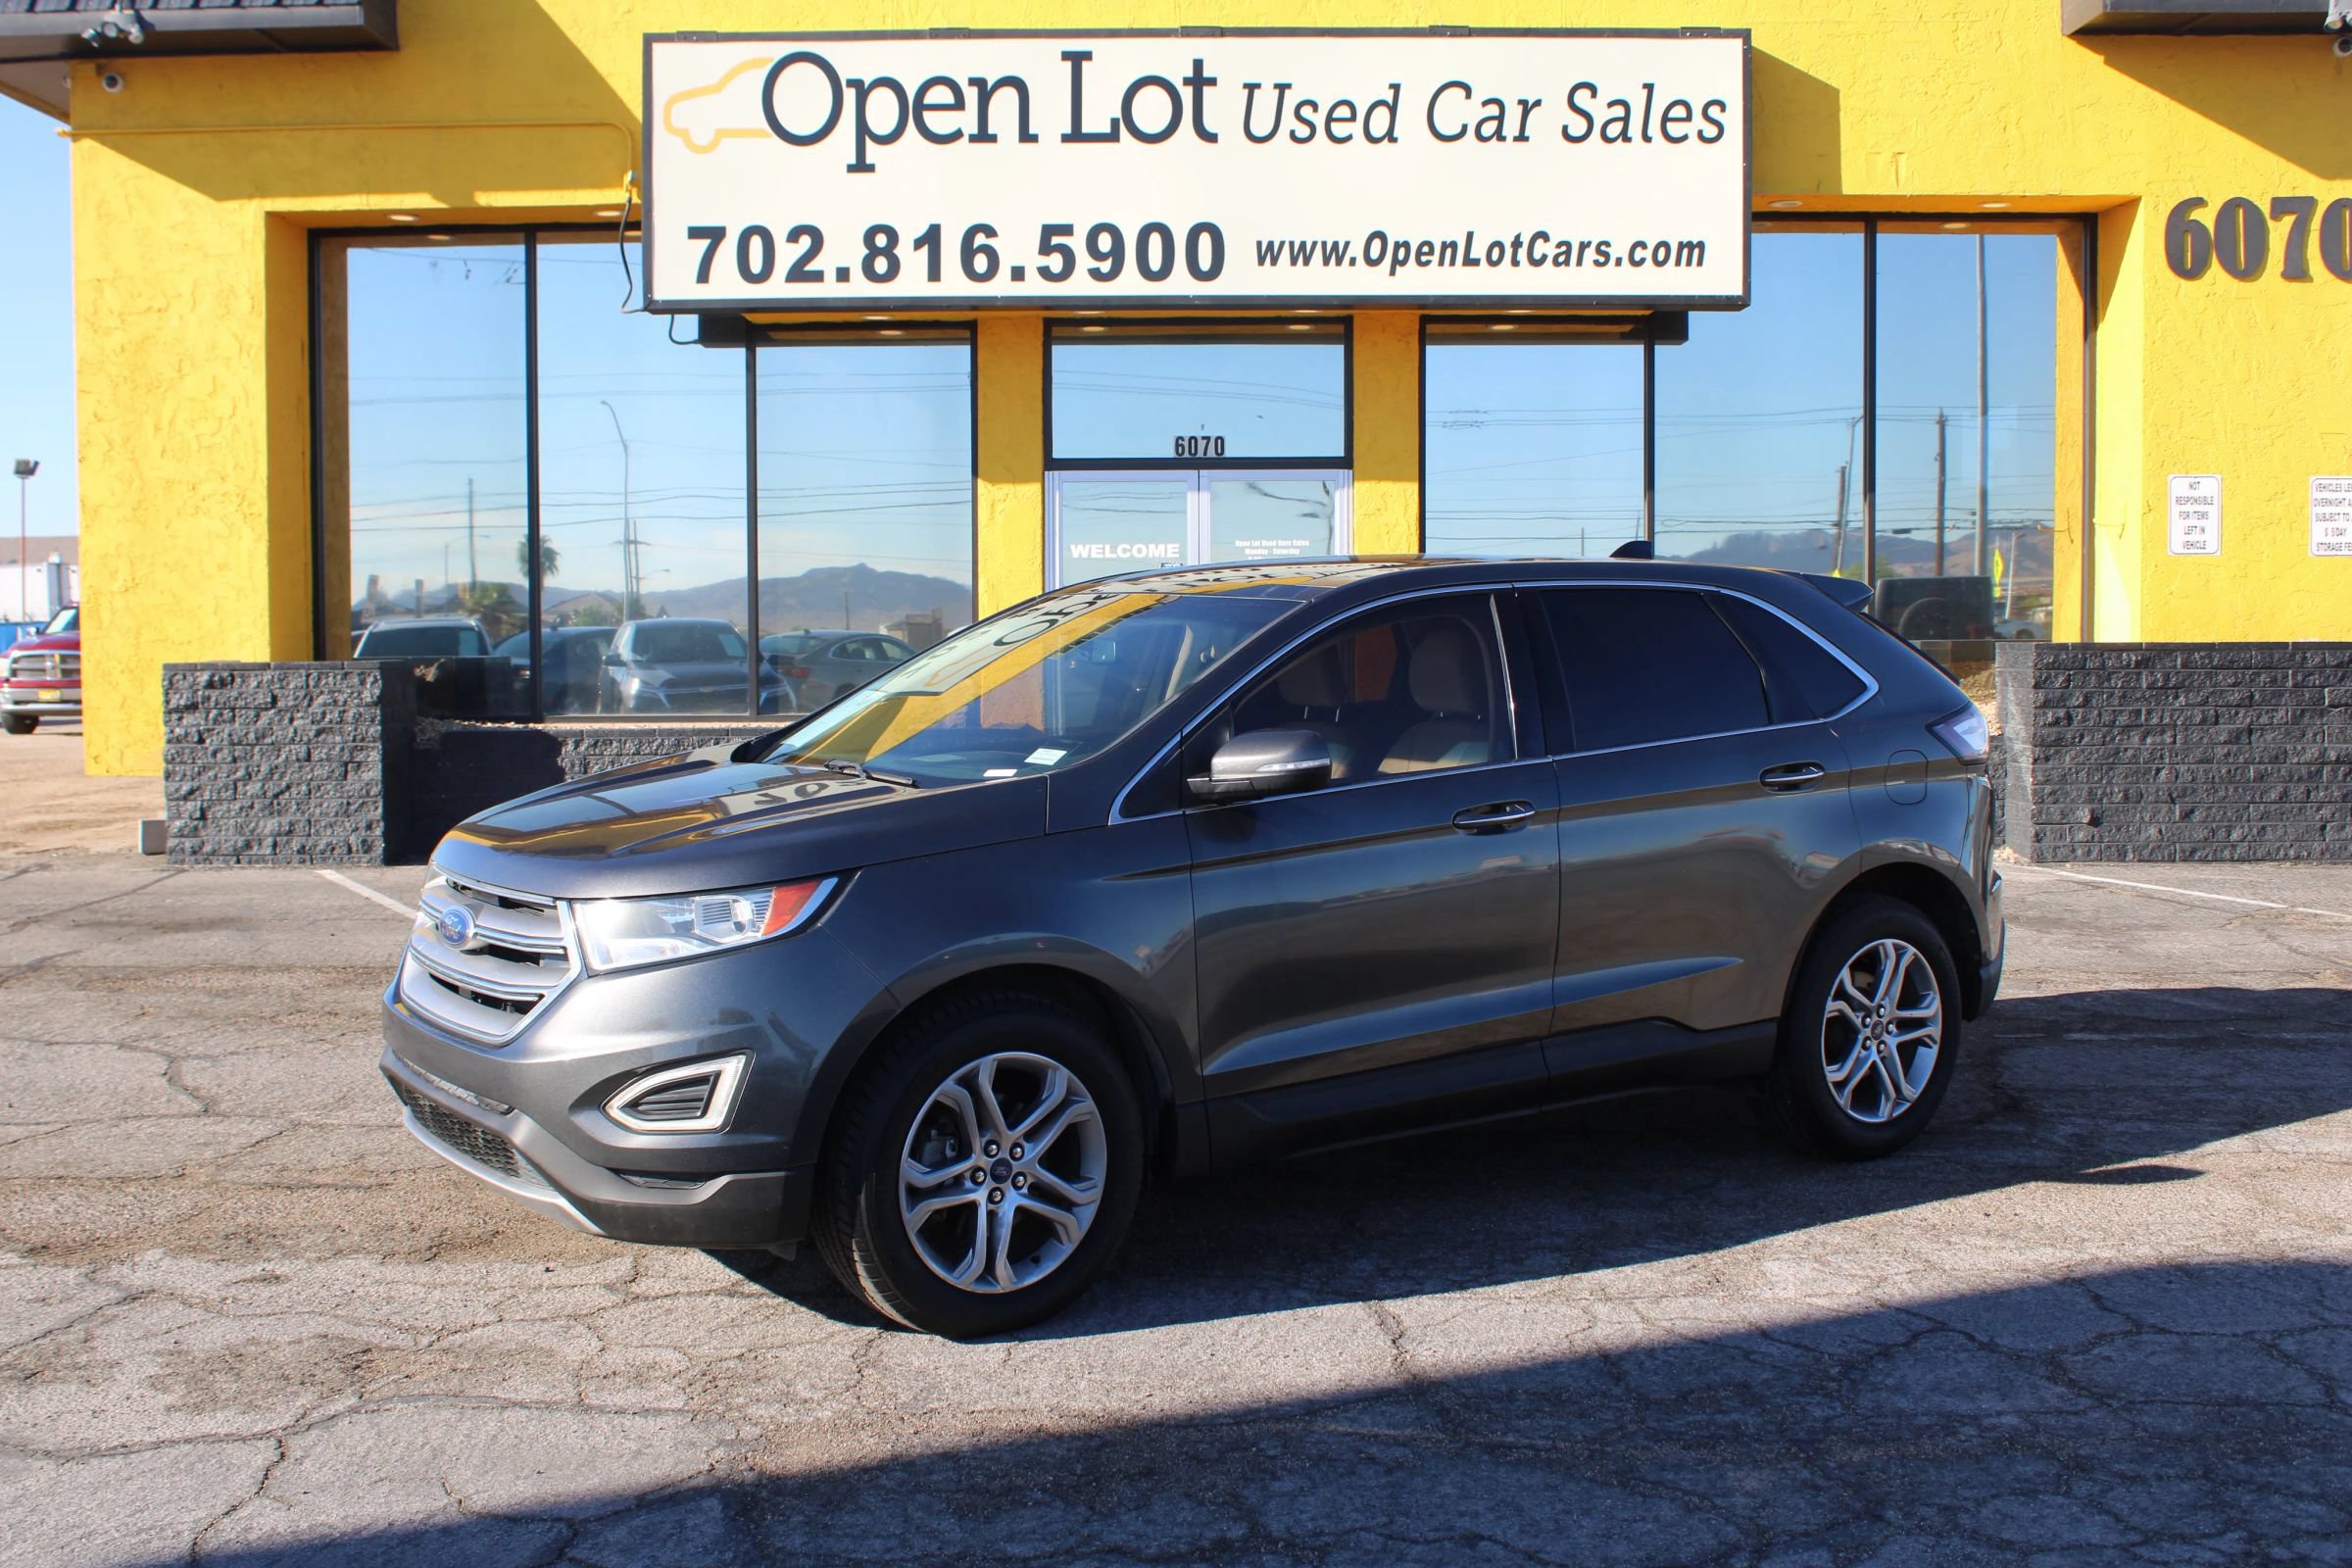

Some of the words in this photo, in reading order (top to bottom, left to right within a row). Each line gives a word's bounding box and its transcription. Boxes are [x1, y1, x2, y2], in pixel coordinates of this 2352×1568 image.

[762, 51, 1039, 172] Open
[1061, 51, 1218, 144] Lot
[1242, 82, 1401, 144] Used
[1427, 80, 1542, 143] Car
[1561, 81, 1727, 144] Sales
[2164, 196, 2352, 282] 6070
[688, 222, 1225, 284] 702.816.5900
[1255, 230, 1706, 276] www.OpenLotCars.com
[1175, 436, 1225, 457] 6070
[2188, 481, 2201, 491] NOT
[2175, 496, 2214, 506] RESPONSIBLE
[2179, 511, 2190, 520] FOR
[2183, 525, 2197, 535] LEFT
[1070, 543, 1180, 559] WELCOME
[2182, 541, 2207, 550] VEHICLE
